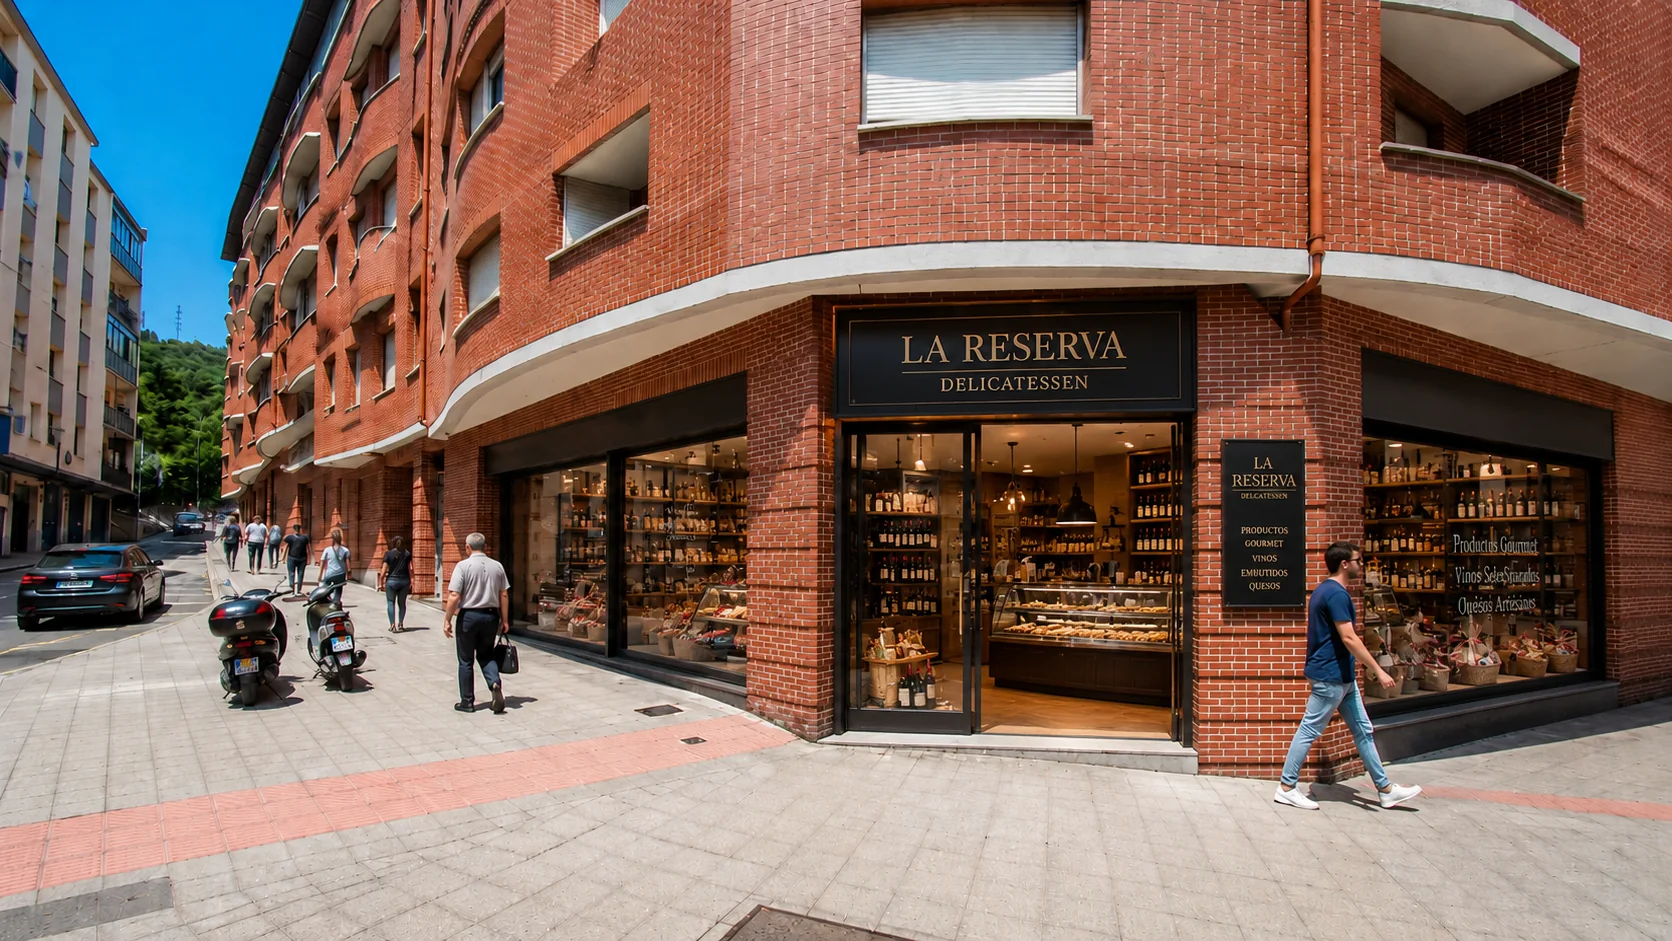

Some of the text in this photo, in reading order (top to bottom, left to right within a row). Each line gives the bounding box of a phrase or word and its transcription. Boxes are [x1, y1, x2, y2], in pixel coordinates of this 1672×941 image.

[902, 330, 1127, 364] LA RESERVA
[940, 375, 1089, 392] DELICATESSEN
[1253, 456, 1273, 470] LA
[1232, 474, 1297, 487] RESERVA
[1241, 526, 1289, 535] PRODUCTOS
[1245, 539, 1284, 548] GOURMET
[1252, 554, 1278, 563] VINOS
[1455, 566, 1482, 584] Vinos
[1249, 582, 1281, 592] QUESOS
